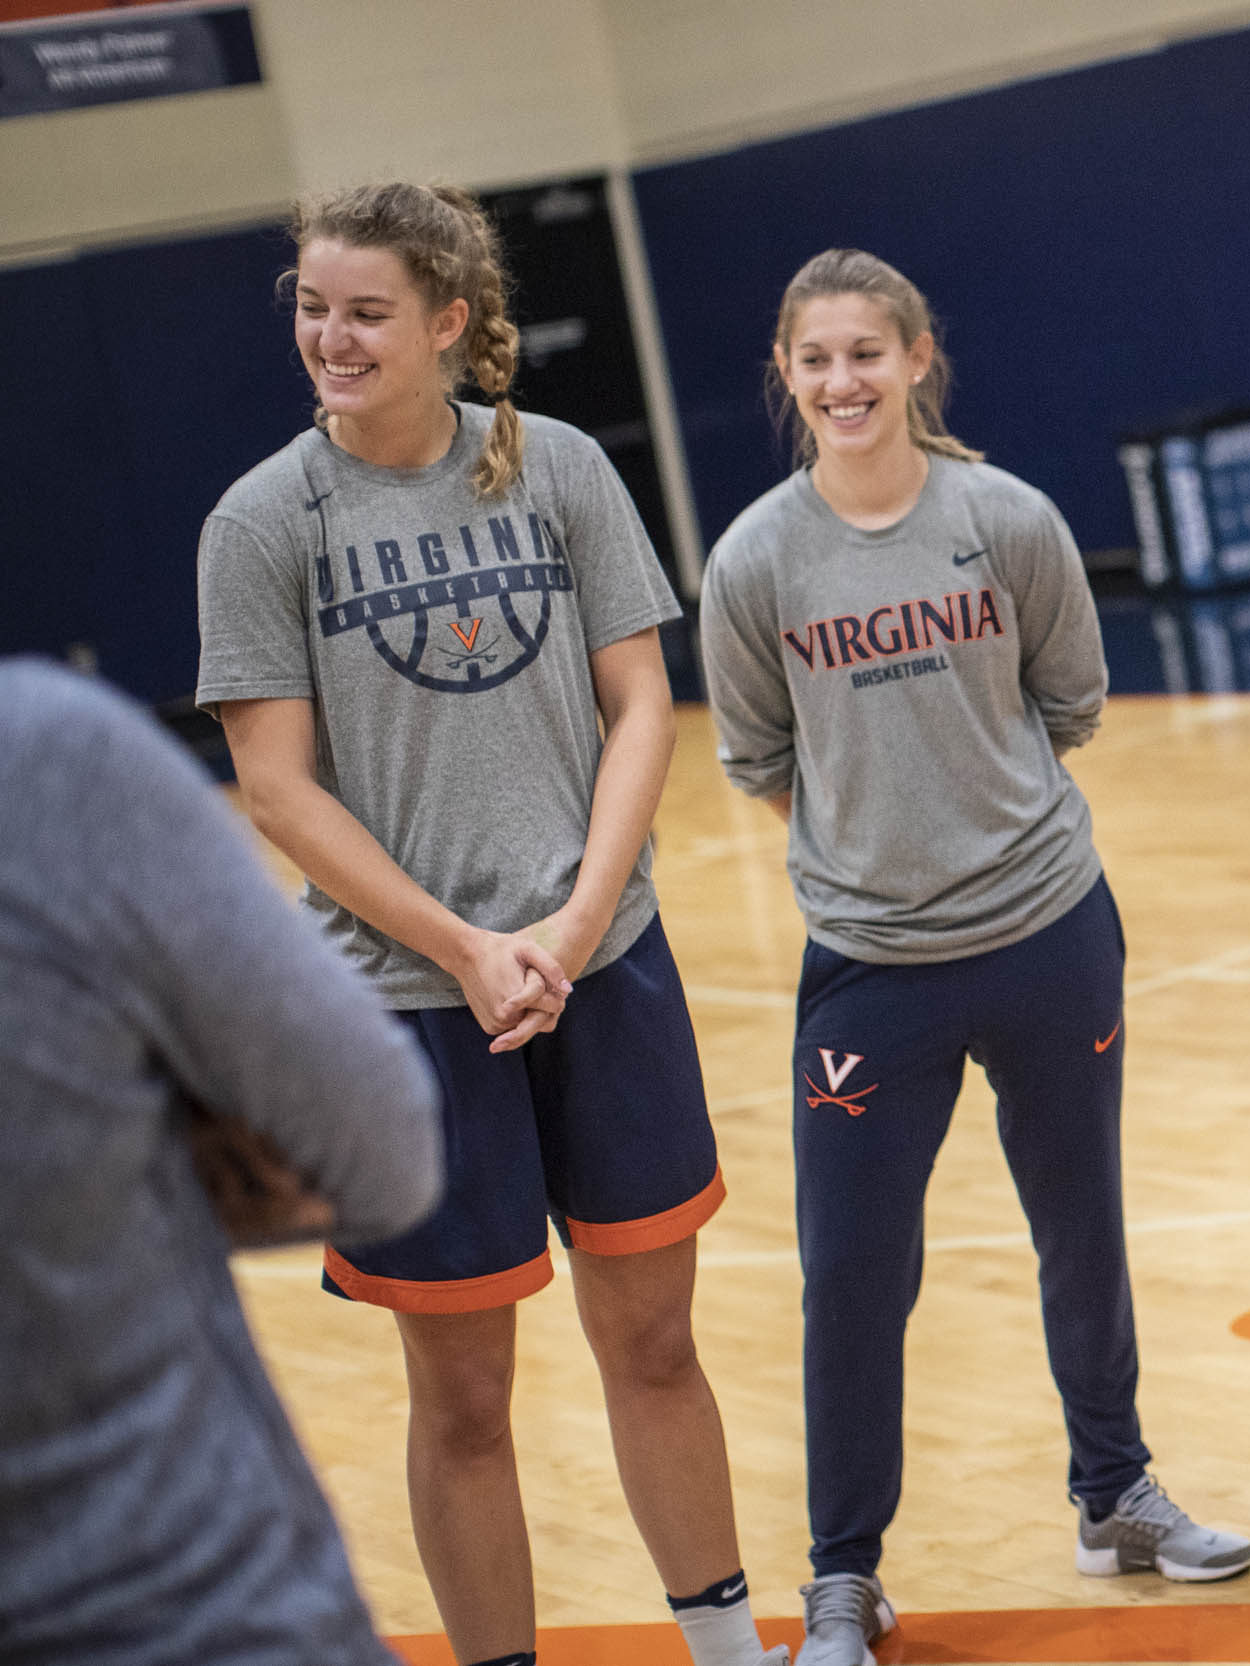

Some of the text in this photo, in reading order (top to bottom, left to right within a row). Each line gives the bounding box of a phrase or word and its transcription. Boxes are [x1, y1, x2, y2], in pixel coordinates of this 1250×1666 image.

[336, 567, 566, 626] BASKETBALL
[781, 589, 1004, 673] VIRGINIA
[852, 655, 949, 689] BASKETBALL
